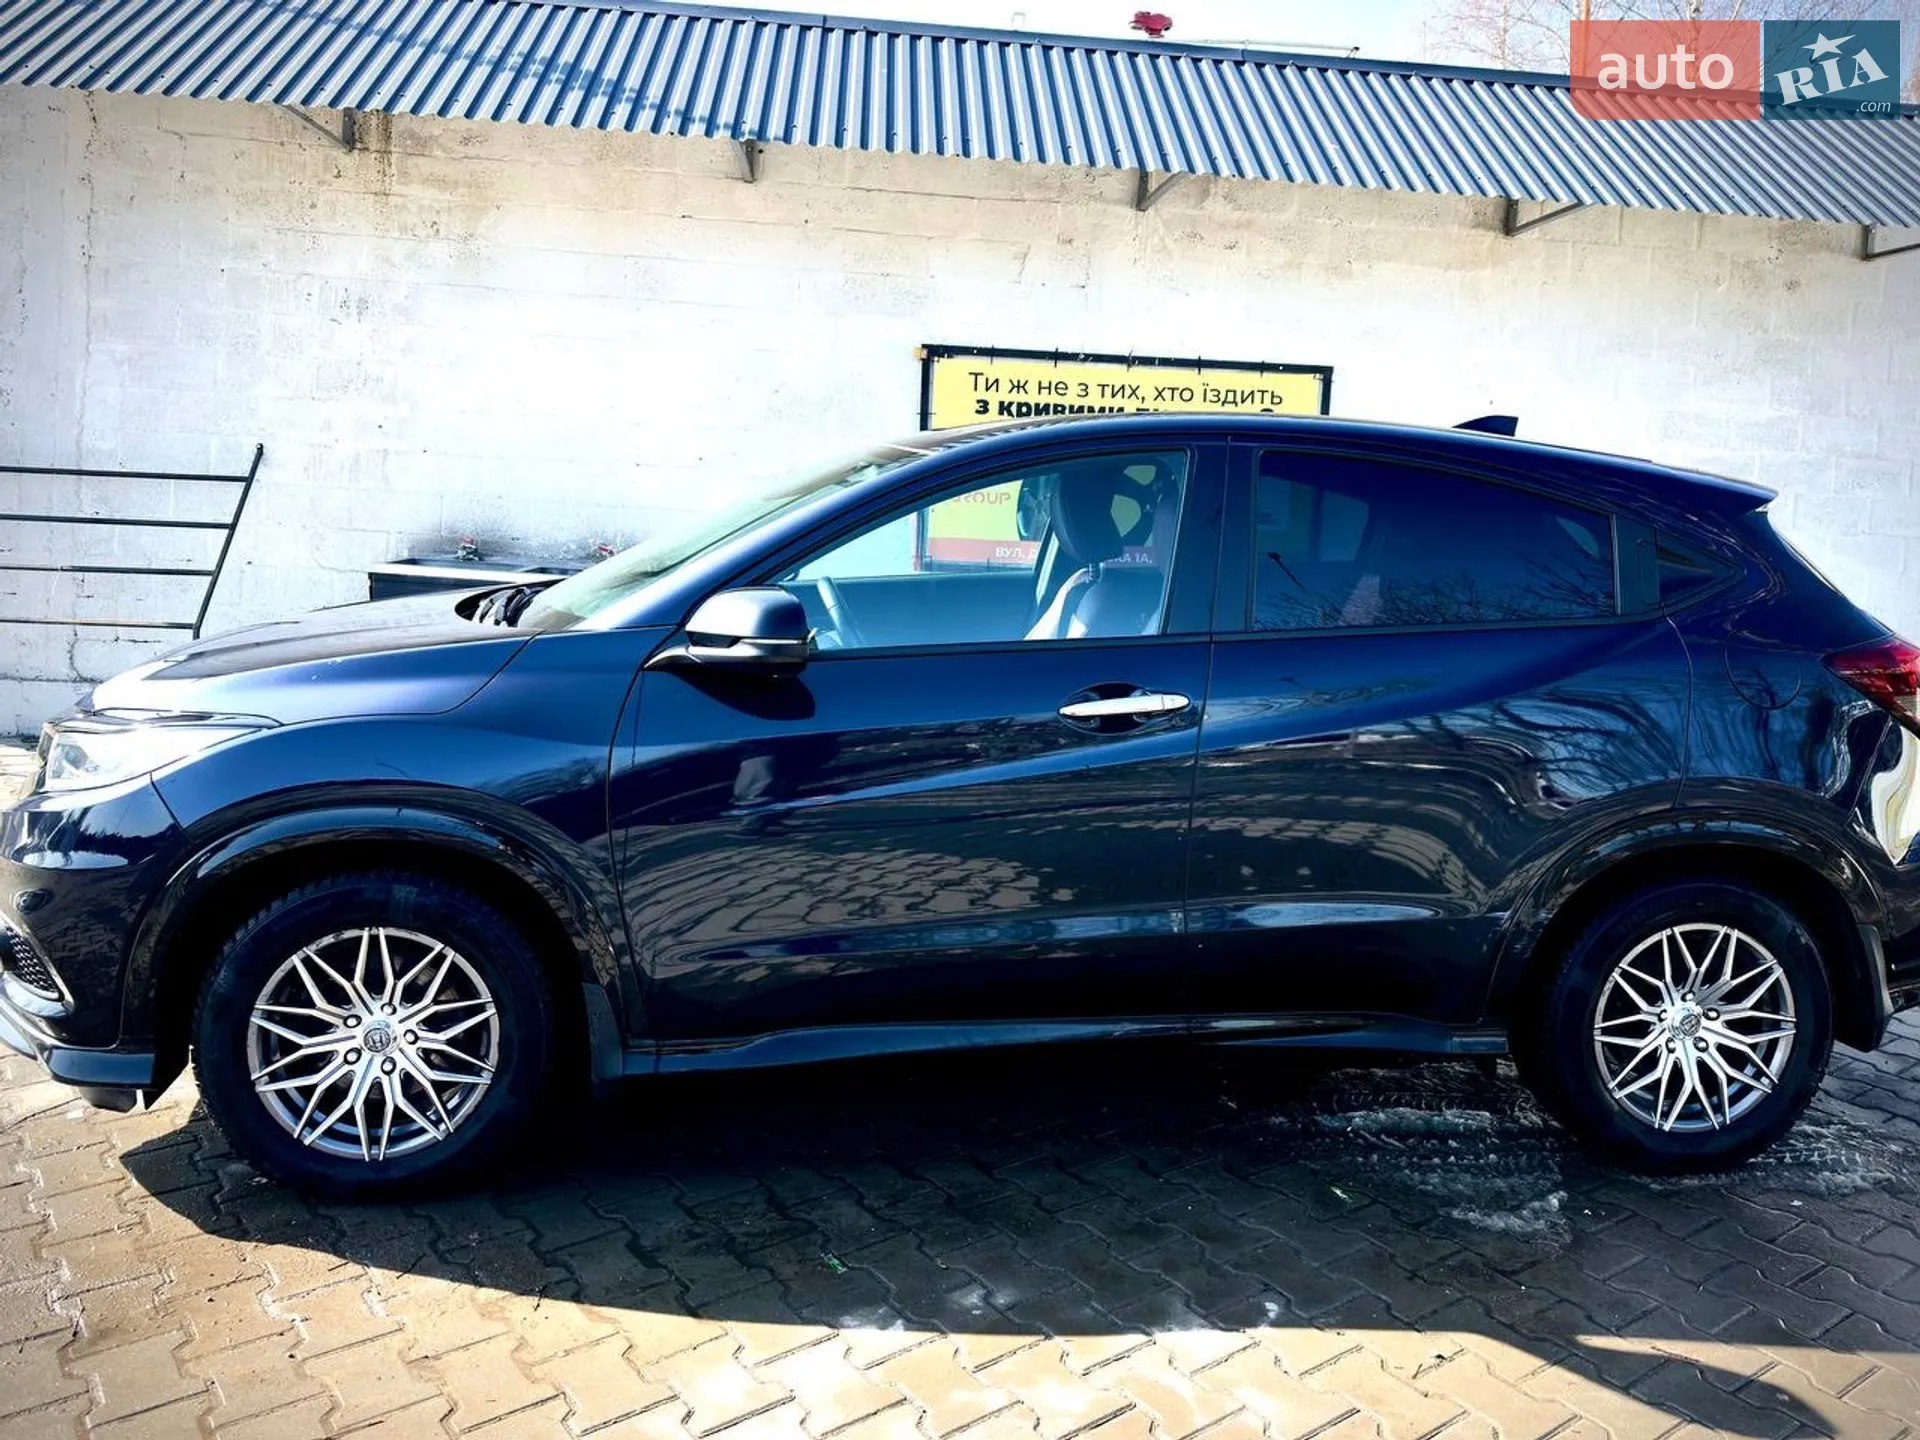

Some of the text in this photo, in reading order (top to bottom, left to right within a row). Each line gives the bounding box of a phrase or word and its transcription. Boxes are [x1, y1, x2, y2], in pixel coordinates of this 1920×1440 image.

[968, 372, 1284, 407] Ти ж не з тих, хто їздить
